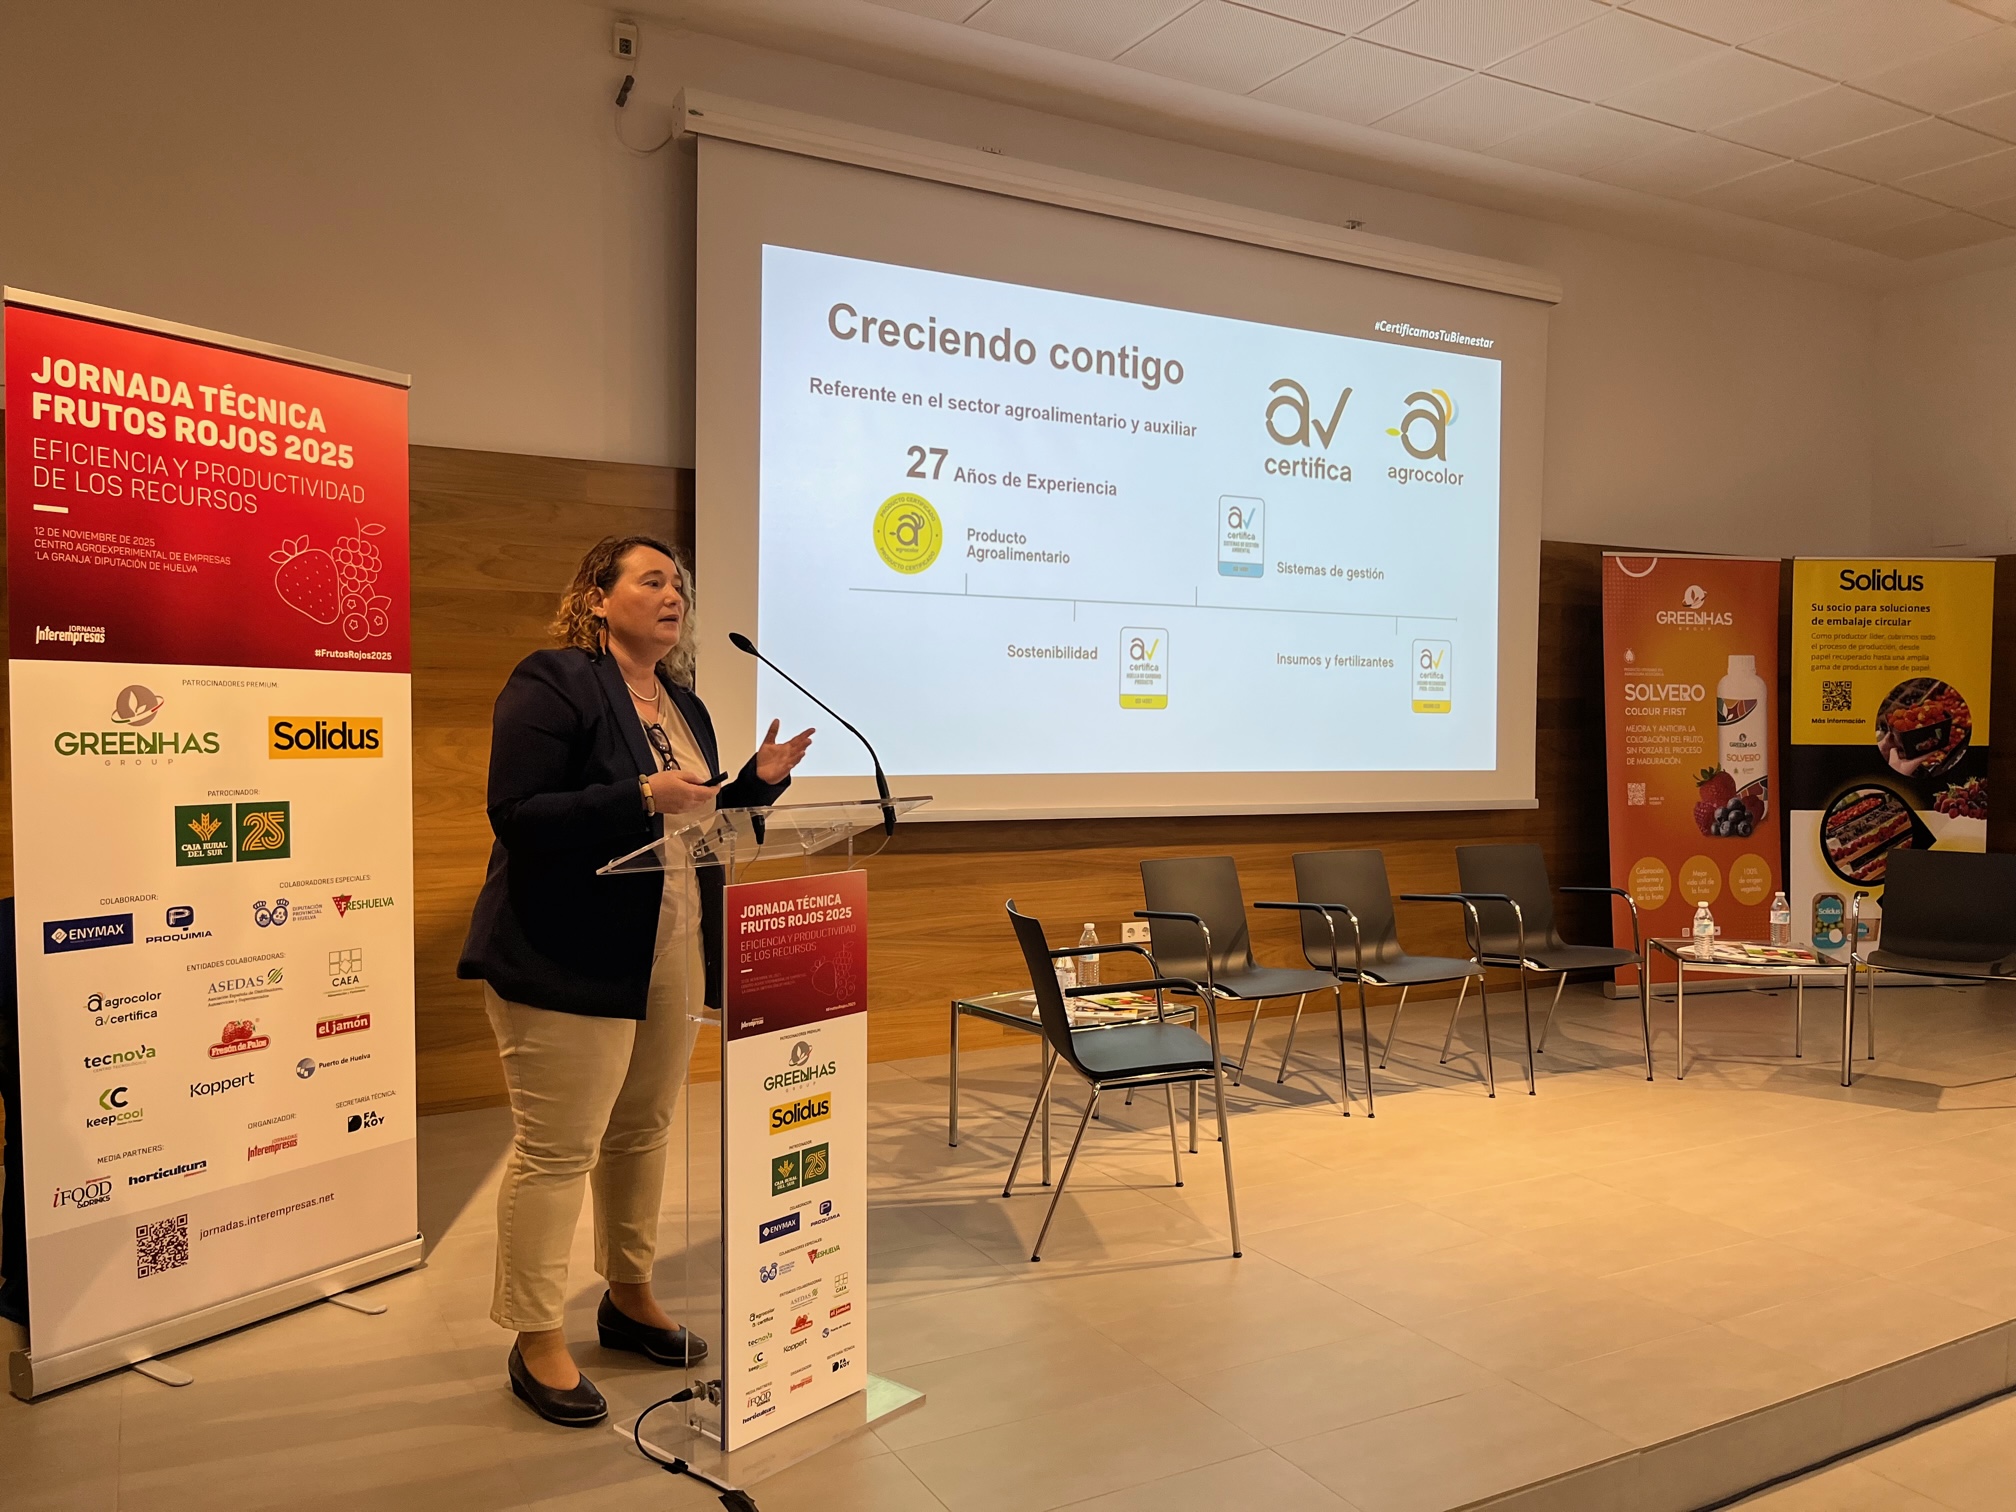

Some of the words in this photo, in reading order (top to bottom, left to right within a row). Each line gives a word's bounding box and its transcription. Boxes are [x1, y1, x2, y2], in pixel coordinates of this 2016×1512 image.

[1374, 320, 1494, 348] #CertificamosTuBienestar
[828, 303, 1037, 365] Creciendo
[1050, 345, 1184, 390] contigo
[31, 356, 194, 409] JORNADA
[199, 384, 326, 433] TÉCNICA
[810, 378, 897, 403] Referente
[902, 392, 923, 406] en
[928, 393, 943, 408] el
[948, 398, 1000, 415] sector
[1005, 404, 1127, 429] agroalimentario
[1131, 418, 1139, 434] y
[1144, 419, 1197, 437] auxiliar
[32, 392, 166, 439] FRUTOS
[175, 416, 277, 457] ROJOS
[284, 436, 354, 469] 2025
[33, 437, 168, 476] EFICIENCIA
[173, 458, 188, 478] Y
[195, 462, 365, 504] PRODUCTIVIDAD
[906, 445, 949, 480] 27
[954, 468, 997, 486] Años
[1002, 472, 1022, 487] de
[1027, 474, 1117, 496] Experiencia
[1264, 457, 1352, 482] certifica
[1388, 466, 1464, 486] agrocolor
[34, 466, 66, 490] DE
[75, 471, 123, 496] LOS
[132, 479, 258, 514] RECURSOS
[880, 497, 905, 518] PRODUCTO
[906, 497, 935, 521] CERTIFICADO
[34, 527, 44, 536] 12
[47, 528, 60, 537] DE
[62, 529, 117, 543] NOVIEMBRE
[120, 535, 130, 544] DE
[133, 536, 155, 547] 2025
[967, 528, 1026, 545] Producto
[1228, 532, 1255, 540] certifica
[34, 539, 74, 551] CENTRO
[76, 543, 167, 560] AGROEXPERIMENTAL
[169, 551, 181, 561] DE
[184, 554, 231, 565] EMPRESAS
[967, 545, 1070, 564] Agroalimentario
[1277, 561, 1327, 577] Sistemas
[1330, 565, 1343, 577] de
[1346, 567, 1384, 581] gestión
[1839, 569, 1923, 591] Solidus
[1811, 603, 1823, 611] Su
[1827, 603, 1852, 612] socio
[1854, 605, 1877, 613] para
[1880, 604, 1931, 613] soluciones
[1656, 611, 1733, 625] GREENHAS
[1811, 617, 1824, 625] de
[1827, 617, 1872, 628] embalaje
[1875, 618, 1911, 626] circular
[36, 625, 105, 645] Interempresas
[314, 649, 393, 661] #FrutosRojos2025
[1007, 645, 1098, 660] Sostenibilidad
[1819, 644, 1847, 652] proceso
[1130, 663, 1159, 671] certifica
[1277, 653, 1321, 666] Insumos
[1325, 657, 1331, 669] y
[1334, 655, 1394, 668] fertilizantes
[1811, 654, 1830, 662] papel
[1832, 654, 1871, 662] recuperado
[1907, 654, 1929, 662] amplia
[1843, 664, 1876, 672] productos
[182, 679, 245, 688] PATROCINADORES
[246, 681, 280, 689] PREMIUM:
[1625, 684, 1705, 702] SOLVERO
[1625, 708, 1660, 716] COLOUR
[1663, 708, 1686, 716] FIRST
[54, 731, 220, 756] GREENHAS
[273, 720, 380, 751] Solidus
[1626, 735, 1669, 743] COLORACIÓN
[1626, 746, 1637, 754] SIN
[105, 758, 173, 766] GROUP
[1637, 757, 1681, 765] MADURACIÓN
[207, 788, 260, 797] PATROCINADOR:
[242, 811, 285, 851] 25
[181, 842, 201, 851] CAJA
[203, 841, 227, 850] RURAL
[207, 848, 223, 856] SUR
[280, 878, 334, 888] COLABORADORES
[335, 875, 371, 884] ESPECIALES:
[100, 894, 159, 905] COLABORADOR:
[740, 900, 794, 918] JORNADA
[796, 894, 841, 911] TÉCNICA
[741, 916, 785, 934] FRUTOS
[788, 911, 824, 926] ROJOS
[826, 907, 852, 921] 2025
[69, 923, 124, 940] ENYMAX
[146, 931, 212, 944] PROQUIMIA
[741, 935, 786, 951] EFICIENCIA
[788, 934, 793, 943] Y
[794, 924, 856, 941] PRODUCTIVIDAD
[741, 952, 752, 963] DE
[754, 950, 770, 961] LOS
[773, 942, 816, 958] RECURSOS
[187, 961, 224, 971] ENTIDADES
[226, 953, 285, 966] COLABORADORAS:
[208, 976, 264, 994] ASEDAS
[332, 975, 359, 987] CAEA
[105, 992, 162, 1009] agrocolor
[110, 1010, 158, 1024] certifica
[318, 1024, 331, 1035] el
[332, 1015, 368, 1032] jamón
[84, 1045, 156, 1069] tecnova
[318, 1060, 339, 1068] Puerto
[350, 1053, 370, 1063] Huelva
[190, 1072, 255, 1097] Koppert
[764, 1061, 836, 1091] GREENHAS
[336, 1095, 370, 1108] SECRETARÍA
[86, 1108, 143, 1128] keepcool
[248, 1113, 296, 1129] ORGANIZADOR:
[364, 1111, 377, 1119] FA
[364, 1117, 384, 1128] KOY
[772, 1099, 829, 1128] Solidus
[97, 1154, 121, 1164] MEDIA
[122, 1144, 164, 1159] PARTNERS:
[248, 1138, 298, 1161] Interempresas
[129, 1160, 207, 1185] horticultura
[200, 1193, 334, 1240] jornadas.interempresas.net
[770, 1218, 796, 1233] ENYMAX
[811, 1213, 840, 1227] PROQUIMIA
[784, 1338, 807, 1353] Koppert
